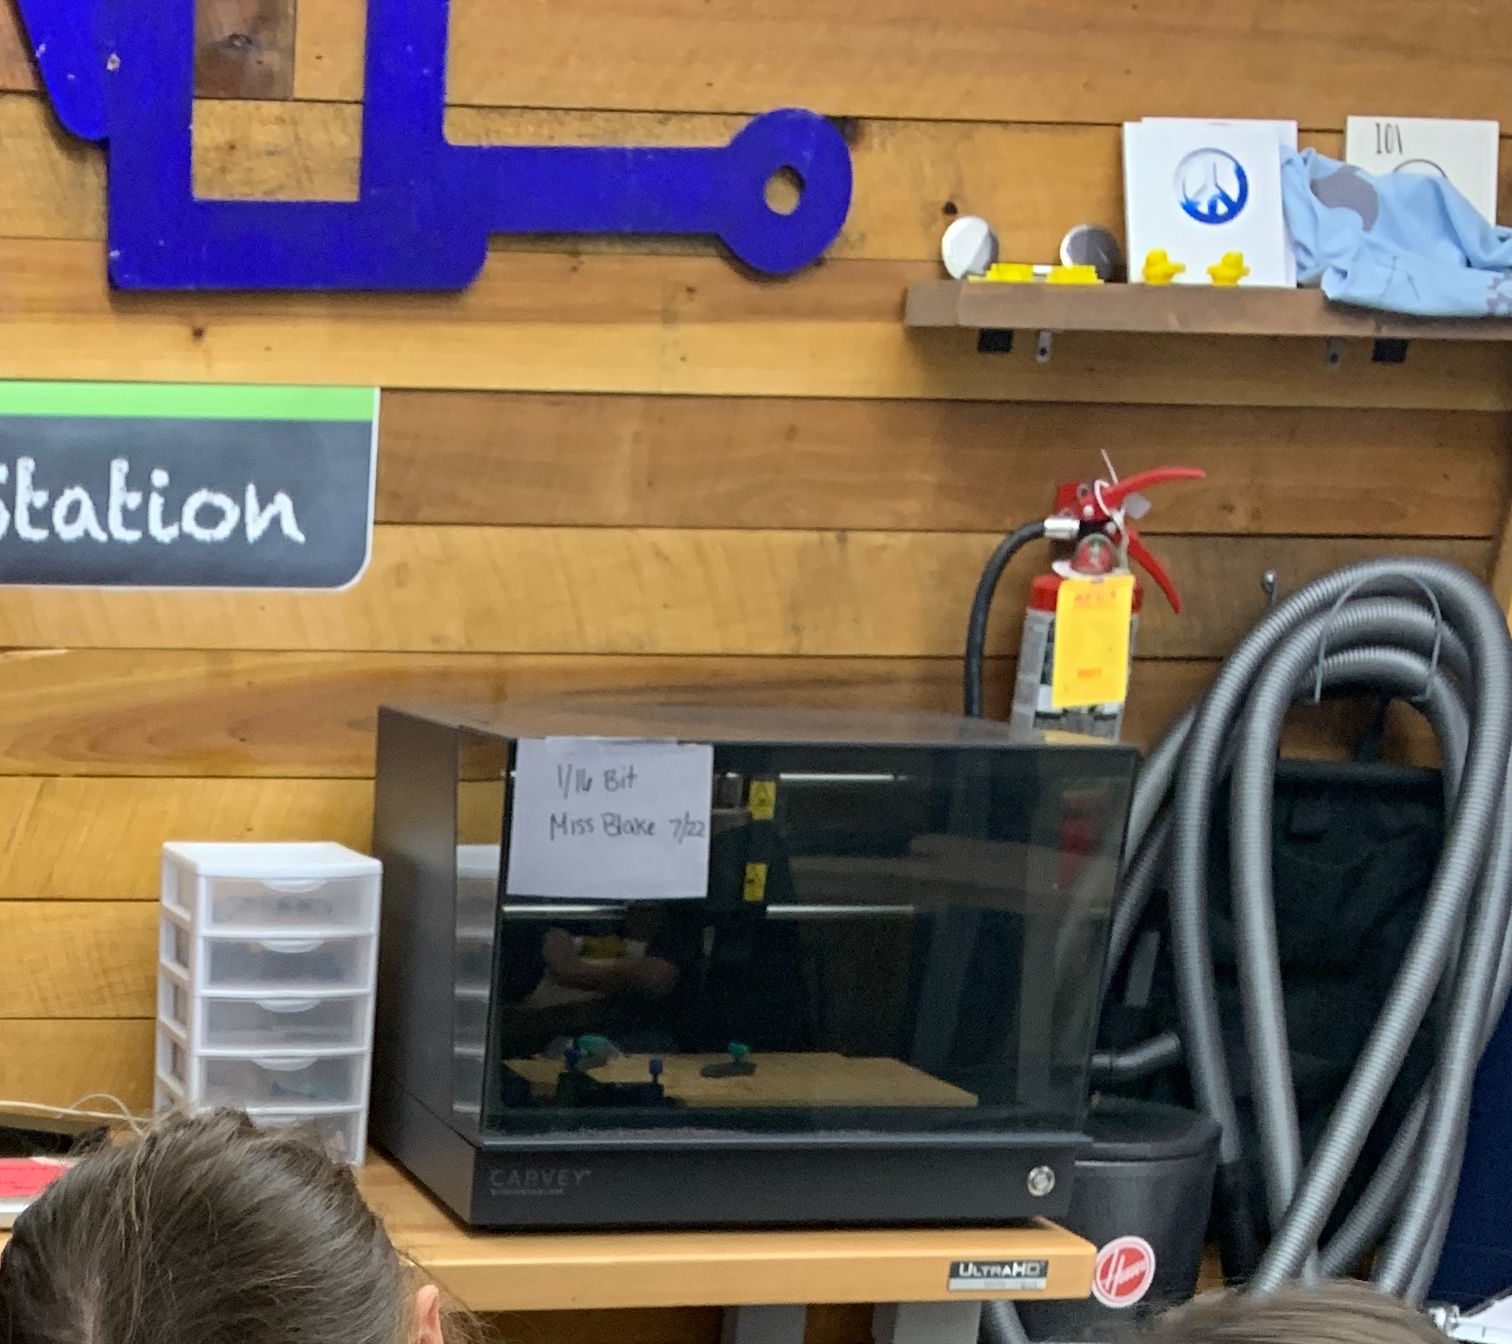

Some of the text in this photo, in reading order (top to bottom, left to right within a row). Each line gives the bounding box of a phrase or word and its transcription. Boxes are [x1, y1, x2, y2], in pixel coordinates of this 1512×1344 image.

[604, 764, 637, 792] Bit
[550, 811, 705, 844] Miss Blake 7/22
